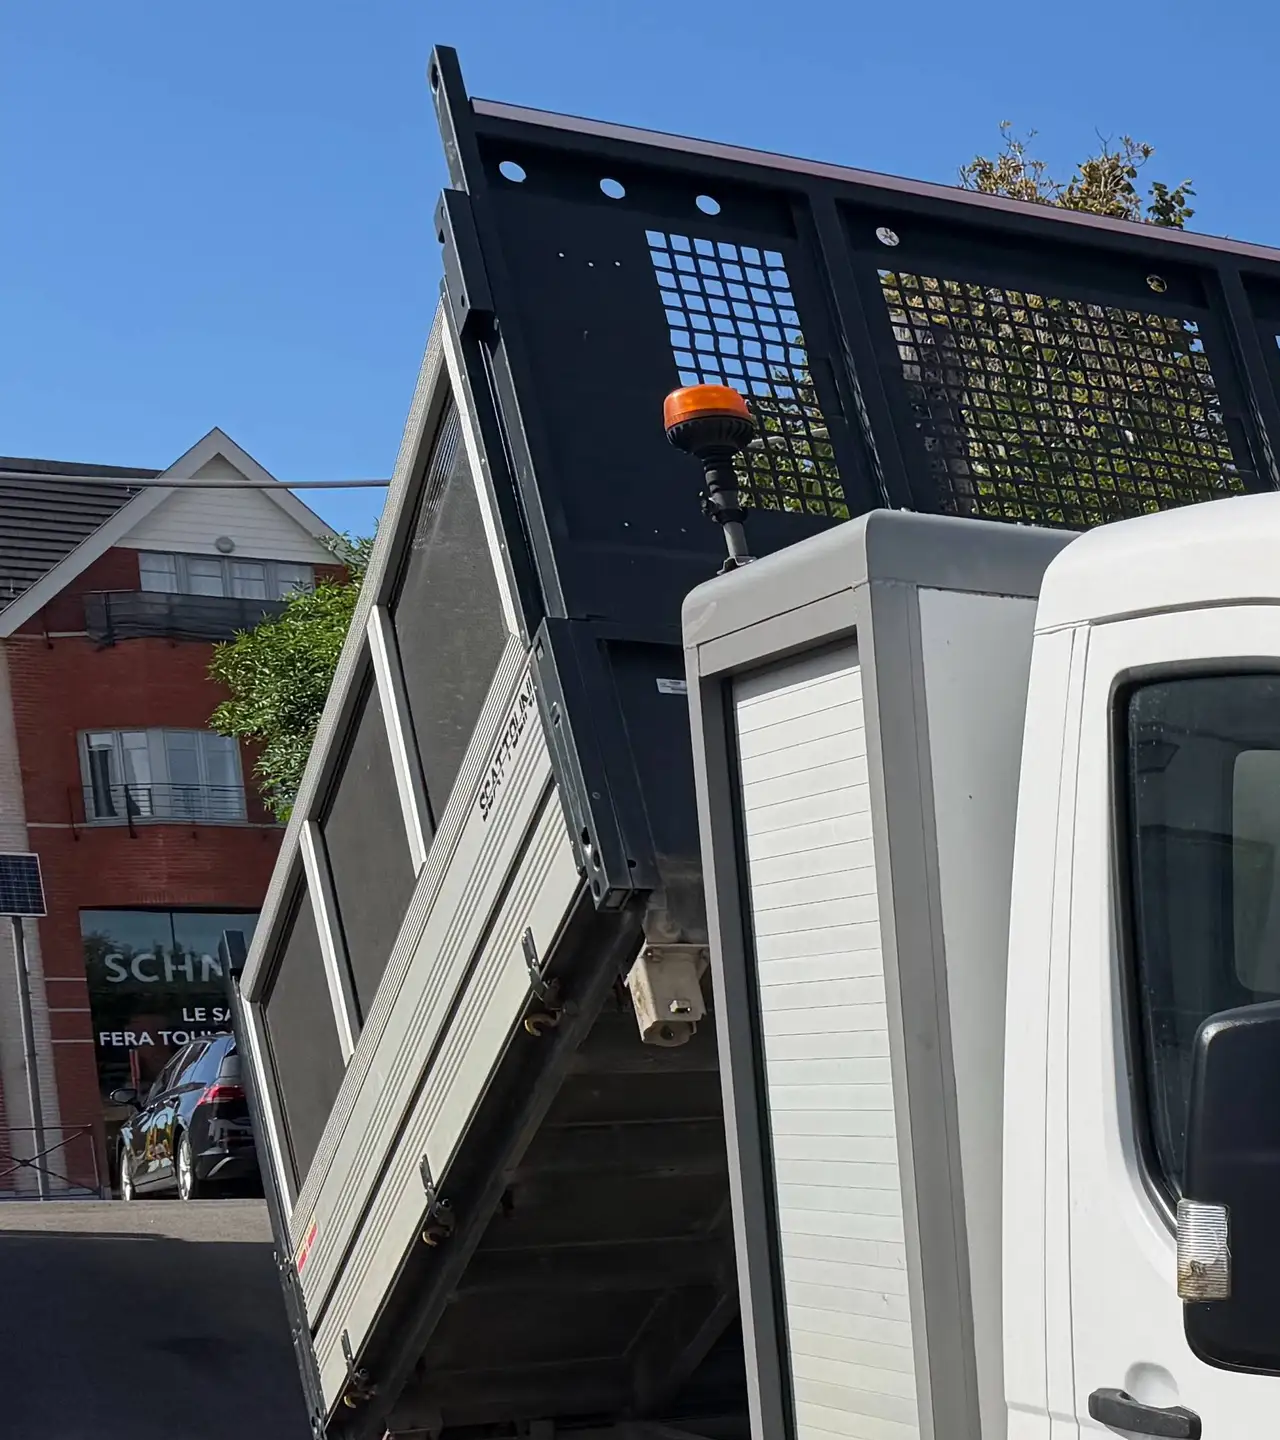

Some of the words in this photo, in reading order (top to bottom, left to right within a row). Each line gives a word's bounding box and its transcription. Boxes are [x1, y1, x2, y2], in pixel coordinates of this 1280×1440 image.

[479, 677, 535, 822] SCATTOLINI
[182, 1007, 207, 1022] LE
[99, 1031, 155, 1046] FERA
